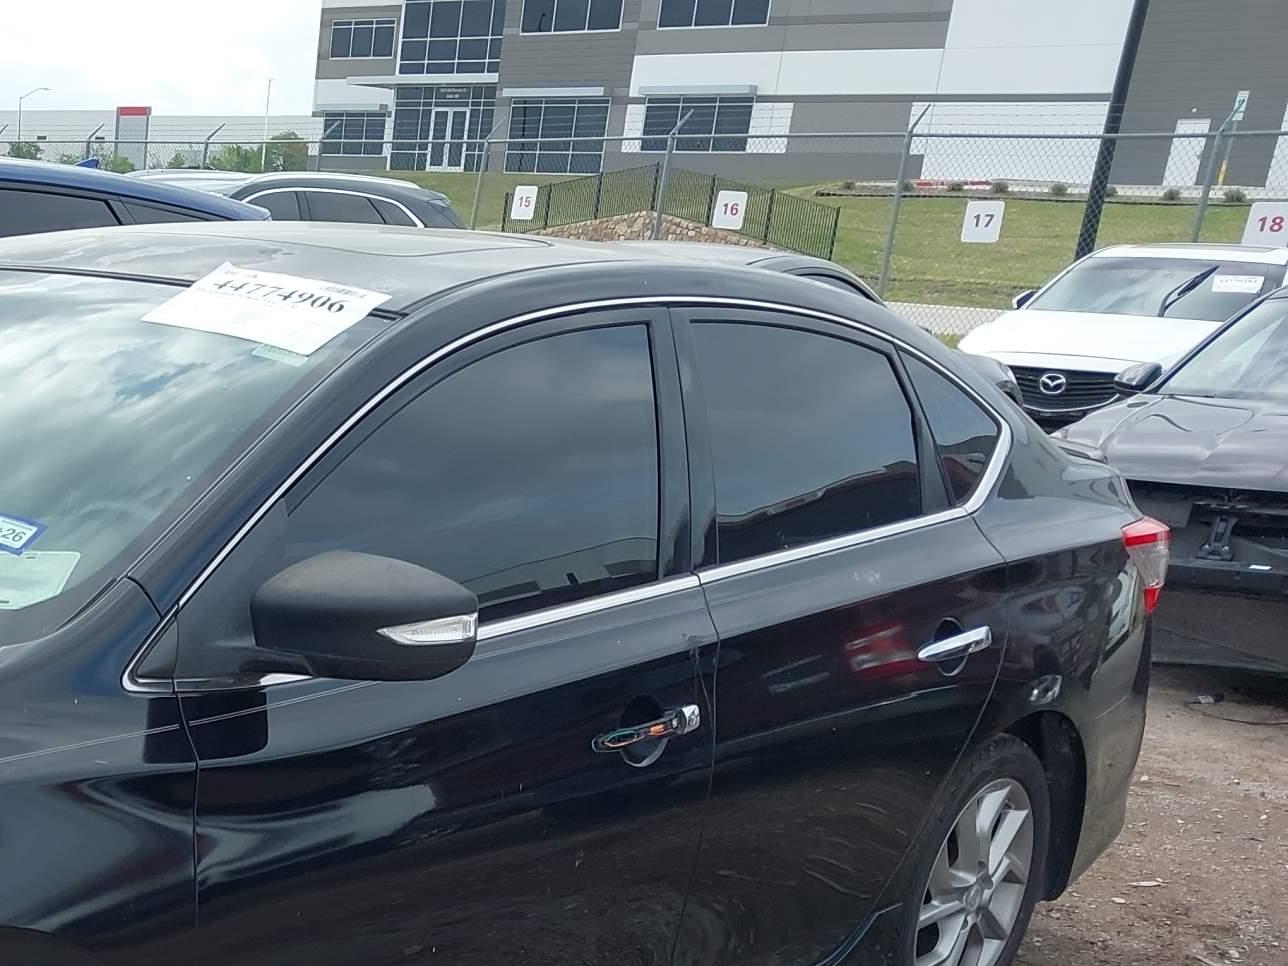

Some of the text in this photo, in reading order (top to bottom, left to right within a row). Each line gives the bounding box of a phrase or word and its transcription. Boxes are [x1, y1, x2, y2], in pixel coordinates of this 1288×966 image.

[519, 195, 532, 208] 15
[722, 202, 739, 216] 16
[974, 213, 995, 228] 17
[1258, 215, 1285, 233] 18
[213, 278, 352, 314] 44774906
